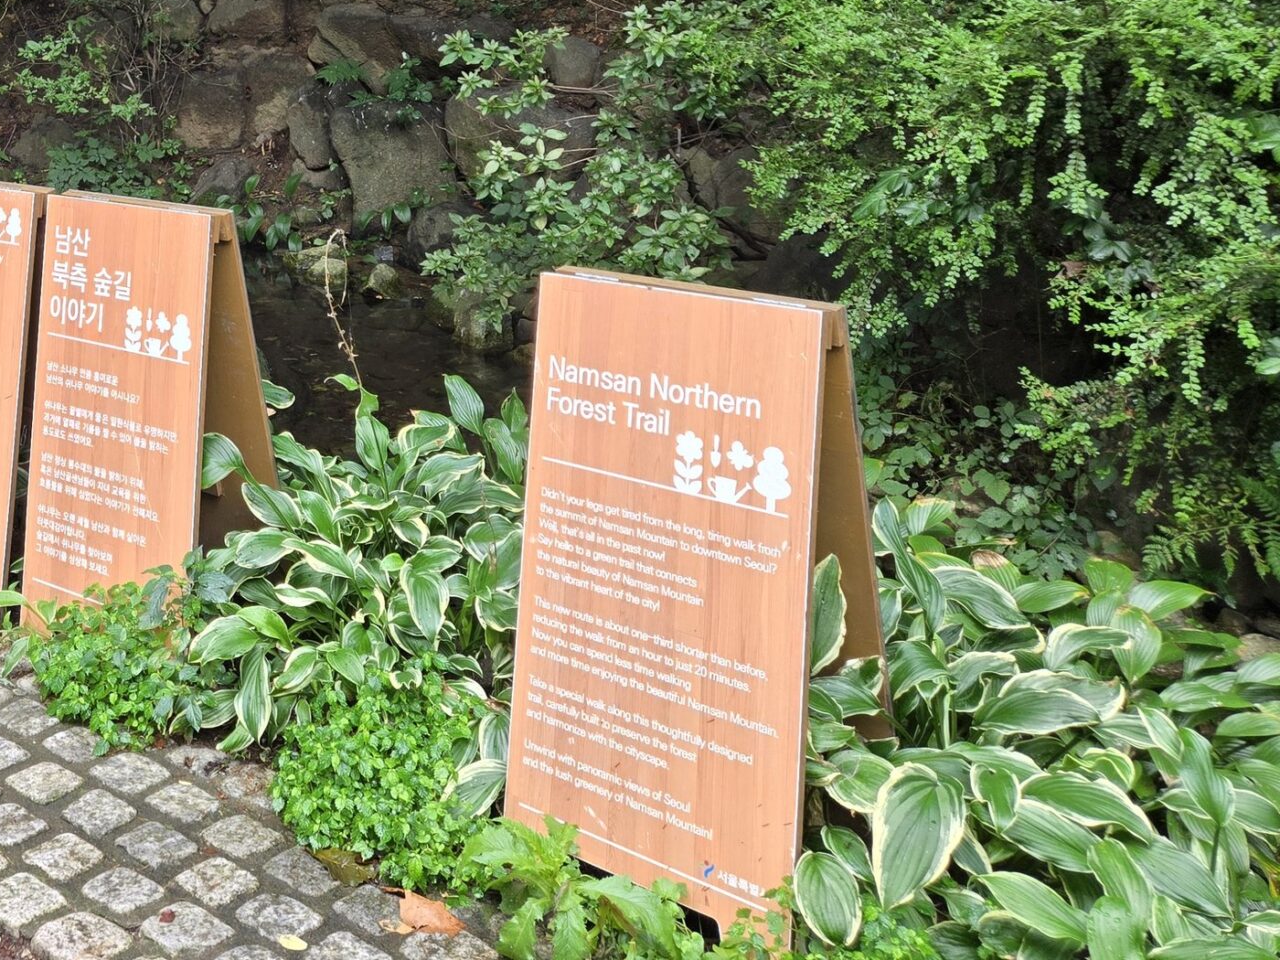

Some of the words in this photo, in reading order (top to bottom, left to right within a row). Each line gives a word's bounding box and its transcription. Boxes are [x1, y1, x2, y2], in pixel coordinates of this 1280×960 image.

[55, 225, 91, 257] 남산
[51, 260, 87, 293] 북측
[94, 267, 132, 301] 숲길
[50, 295, 104, 333] 이야기
[47, 361, 59, 372] 남산
[549, 355, 641, 396] Namsan
[650, 372, 761, 419] Northern
[546, 386, 616, 425] Forest
[623, 402, 670, 436] Trail
[538, 517, 559, 533] Well,
[585, 531, 595, 542] all
[596, 533, 605, 545] in
[606, 536, 621, 549] the
[621, 542, 642, 555] past
[643, 548, 666, 562] now!
[539, 502, 554, 514] the
[555, 508, 587, 524] summit
[588, 516, 597, 525] of
[599, 518, 634, 536] Namsan
[636, 528, 678, 548] Mountain
[679, 540, 690, 552] to
[690, 543, 742, 565] downtown
[743, 556, 778, 575] Seoul?
[565, 495, 586, 506] your
[584, 498, 604, 513] legs
[604, 505, 620, 516] get
[620, 508, 642, 522] tired
[641, 512, 664, 527] from
[664, 519, 682, 532] the
[682, 523, 705, 540] long,
[707, 529, 732, 548] tiring
[732, 538, 756, 551] walk
[757, 542, 781, 558] from
[535, 565, 545, 576] to
[545, 568, 560, 581] the
[560, 573, 590, 590] vibrant
[590, 580, 613, 597] heart
[612, 589, 624, 599] of
[625, 592, 641, 605] the
[641, 597, 660, 612] city!
[536, 532, 553, 547] Say
[554, 538, 574, 552] hello
[575, 545, 584, 555] to
[585, 549, 591, 557] a
[592, 551, 617, 564] green
[619, 557, 635, 569] trail
[636, 561, 655, 576] that
[655, 569, 698, 588] connects
[536, 549, 551, 562] the
[552, 556, 580, 569] natural
[581, 561, 610, 580] beauty
[611, 572, 621, 582] of
[622, 573, 659, 594] Namsan
[660, 584, 704, 607] Mountain
[531, 626, 551, 641] Now
[553, 637, 568, 648] you
[569, 642, 585, 654] can
[586, 648, 613, 663] spend
[614, 654, 633, 670] less
[634, 662, 655, 678] time
[656, 671, 692, 692] walking
[532, 613, 568, 633] reducing
[569, 624, 583, 637] the
[584, 630, 604, 643] walk
[606, 635, 626, 651] from
[628, 645, 640, 656] an
[641, 647, 663, 663] hour
[664, 655, 674, 666] to
[674, 662, 693, 673] just
[694, 664, 708, 678] 20
[708, 671, 751, 693] minutes.
[535, 595, 551, 610] This
[552, 603, 571, 616] new
[572, 610, 594, 624] route
[595, 615, 604, 627] is
[604, 619, 630, 635] about
[674, 642, 709, 660] shorter
[710, 652, 732, 668] than
[530, 646, 546, 657] and
[547, 650, 569, 665] more
[570, 657, 591, 672] time
[591, 666, 628, 687] enjoying
[629, 678, 645, 691] the
[646, 682, 686, 705] beautiful
[687, 696, 729, 721] Namsan
[728, 711, 778, 738] Mountain.
[522, 756, 539, 769] and
[539, 761, 554, 775] the
[555, 767, 573, 783] lush
[574, 777, 613, 801] greenery
[613, 793, 624, 804] of
[625, 795, 664, 820] Namsan
[665, 812, 713, 841] Mountain!
[523, 738, 556, 759] Unwind
[557, 753, 576, 767] with
[576, 761, 622, 786] panoramic
[623, 778, 651, 797] views
[651, 790, 662, 801] of
[663, 793, 691, 813] Seoul
